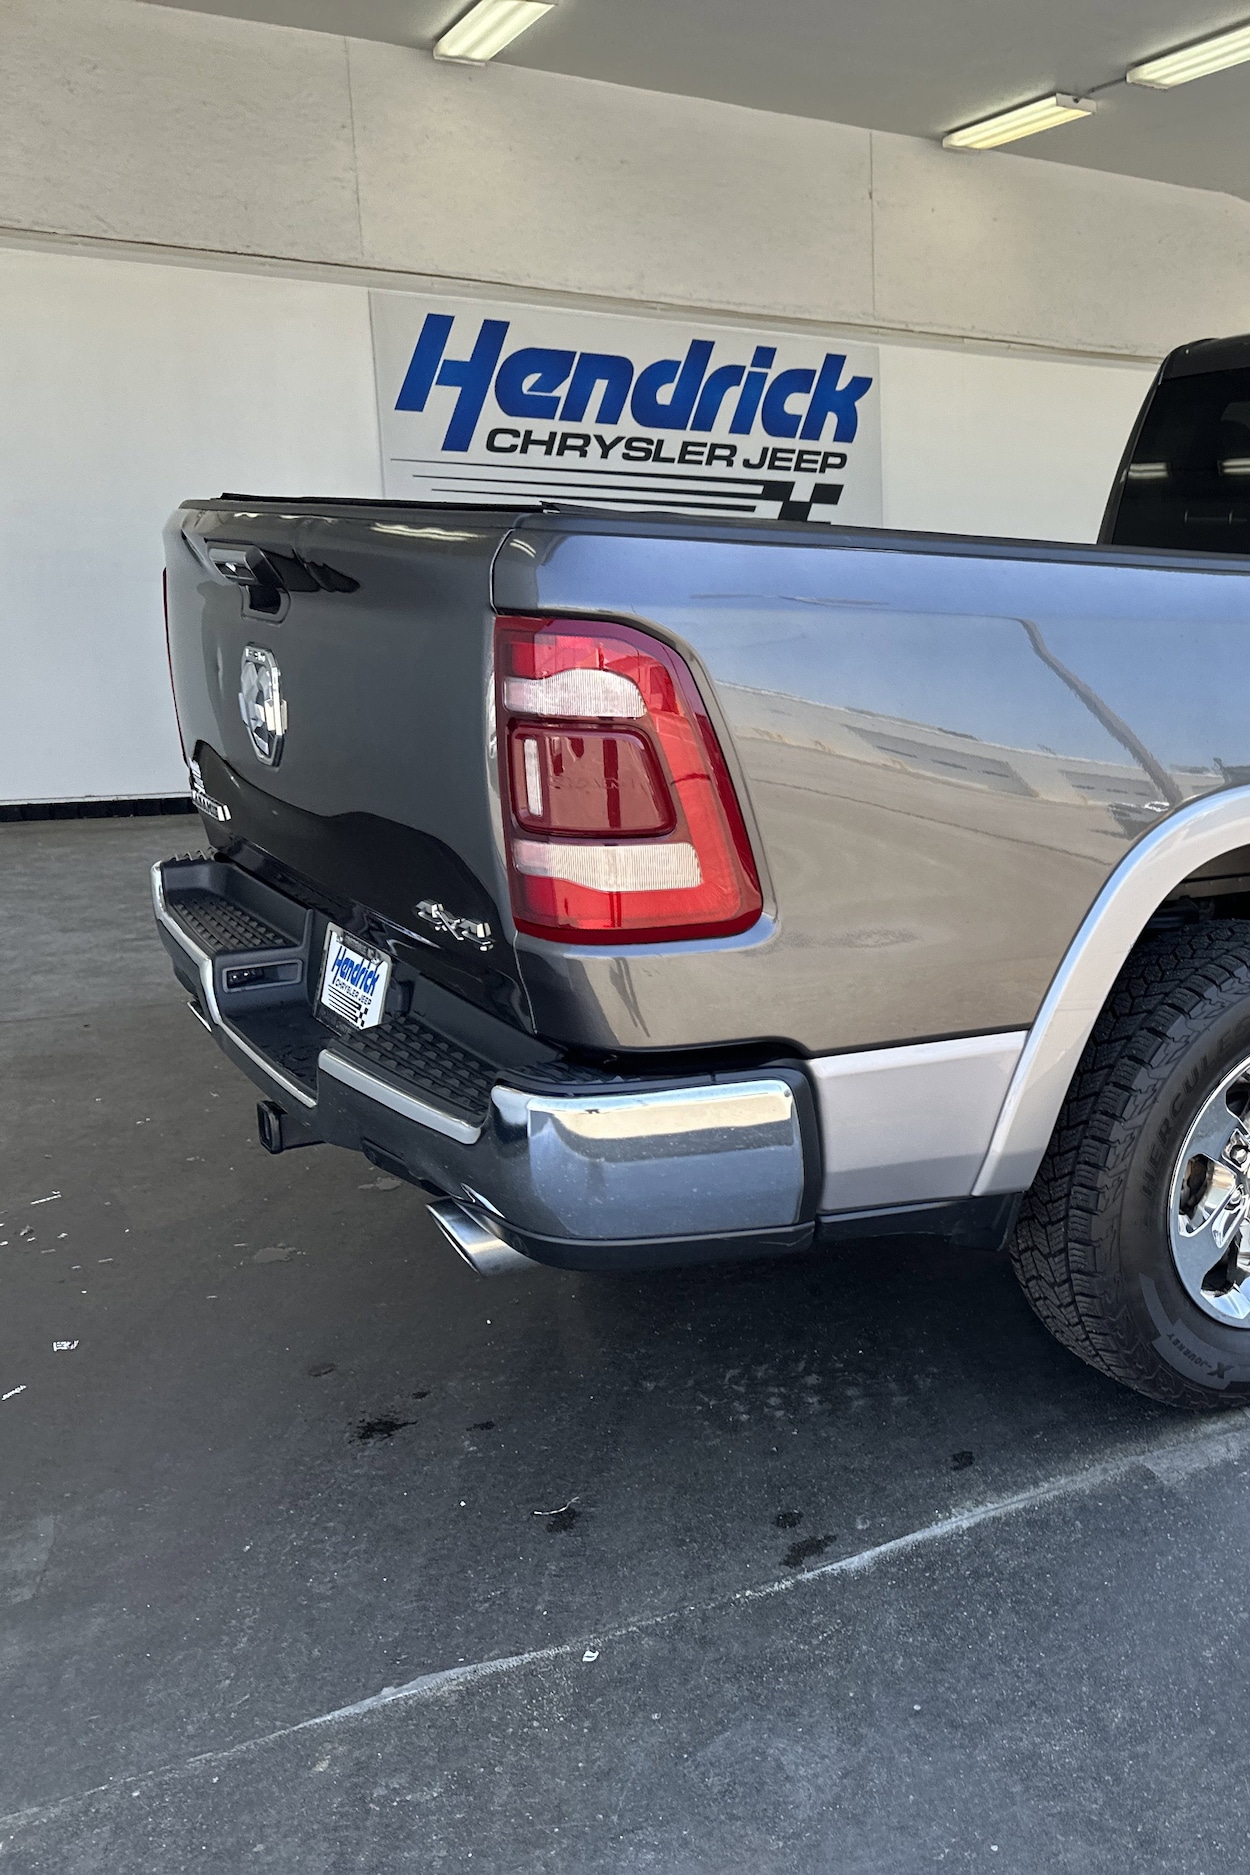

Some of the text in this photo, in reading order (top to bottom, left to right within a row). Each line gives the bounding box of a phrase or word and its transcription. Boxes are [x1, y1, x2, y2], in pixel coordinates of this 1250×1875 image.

[394, 313, 873, 452] Hendrick
[485, 428, 848, 474] CHRYSLER JEEP
[331, 946, 380, 996] Hendrick
[335, 978, 360, 1000] CHRYSLER
[1166, 1332, 1235, 1380] X-JOURNEY
